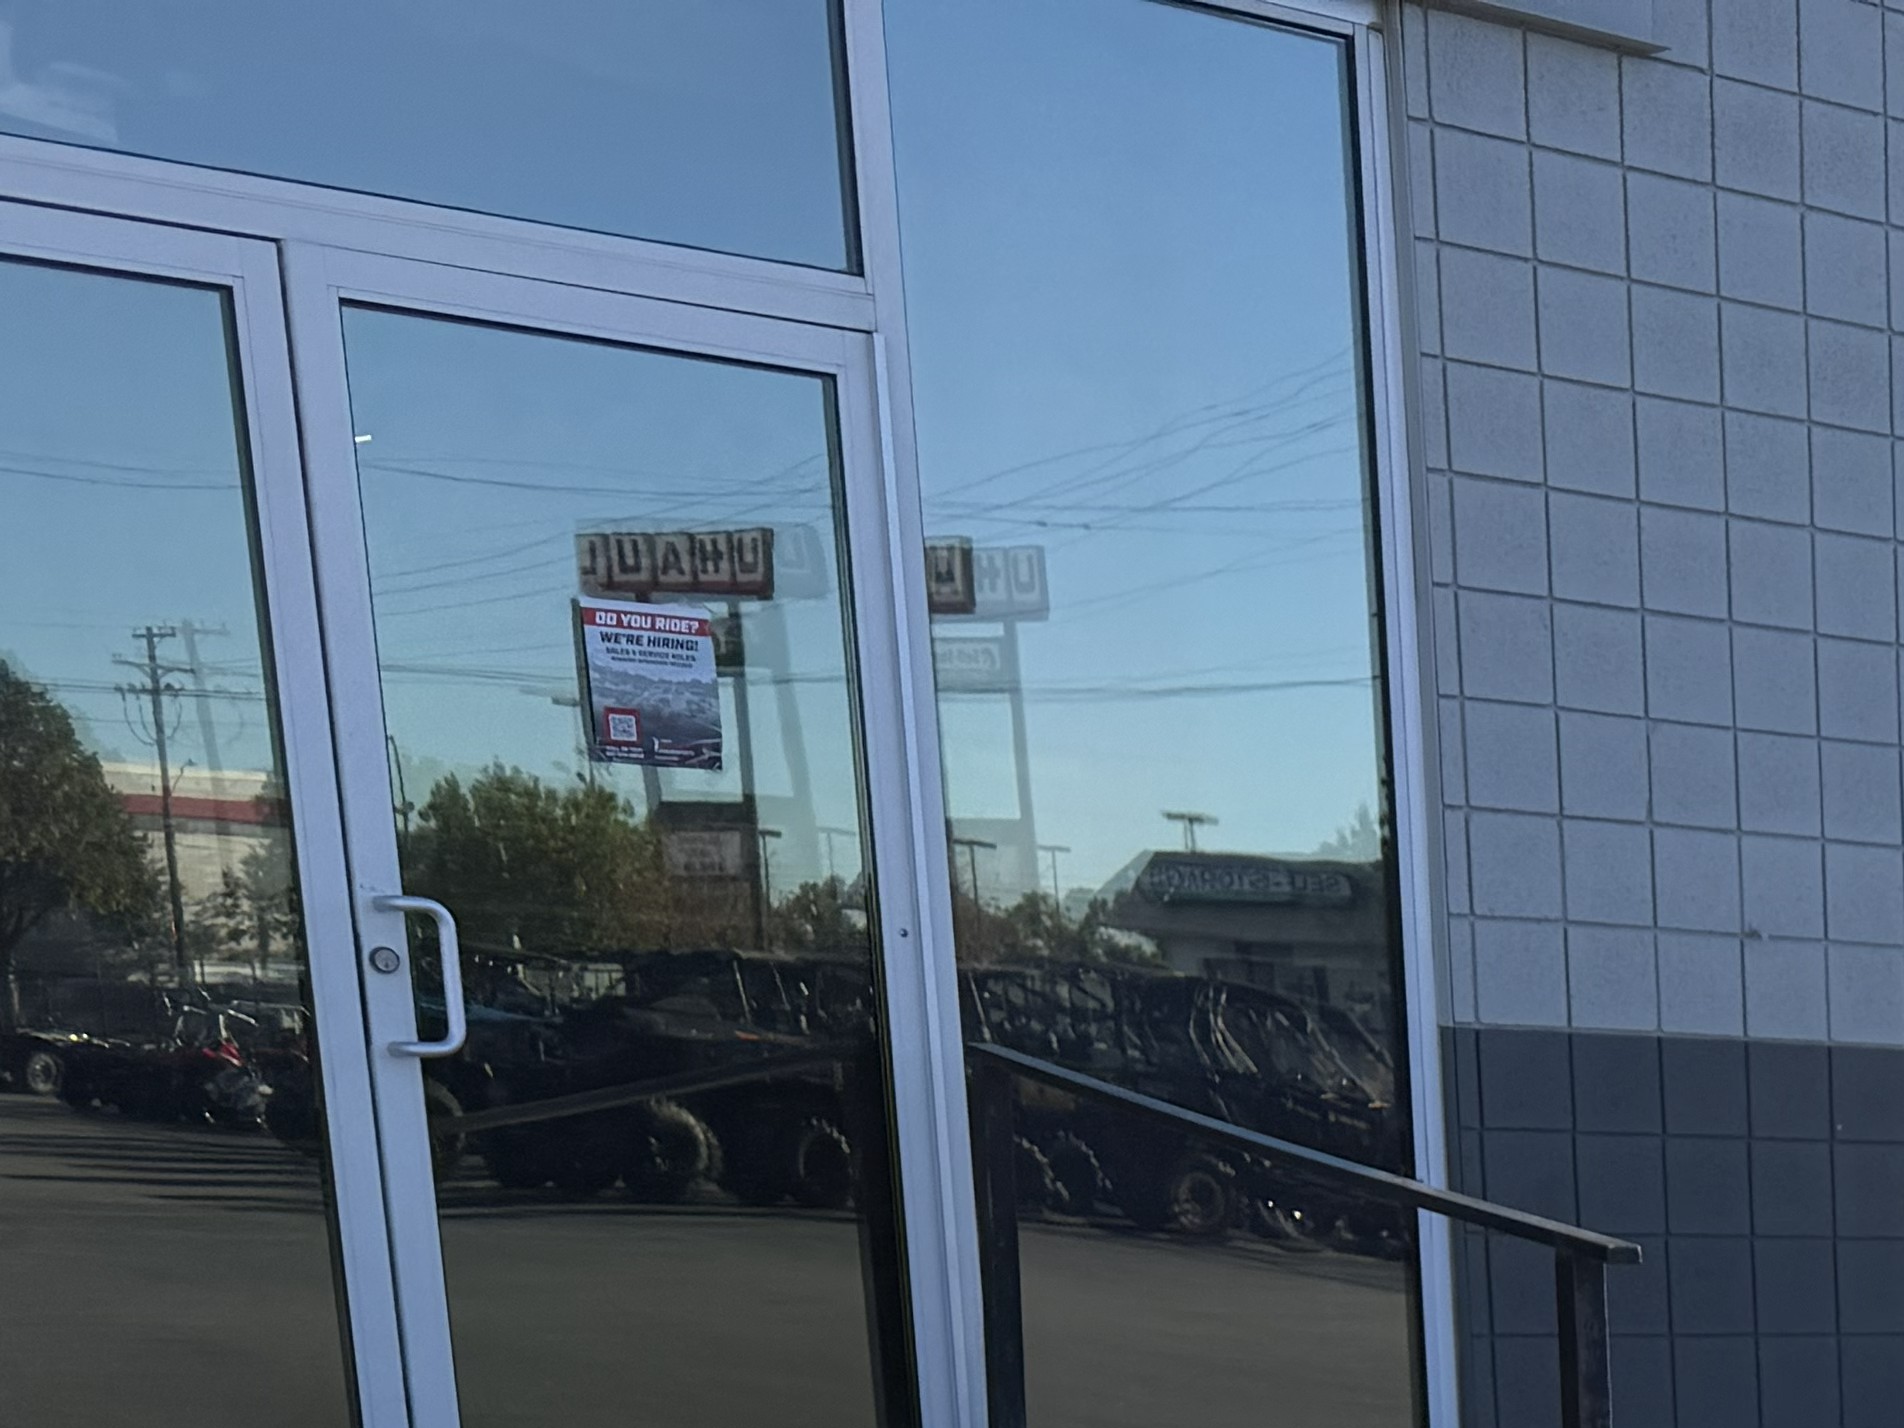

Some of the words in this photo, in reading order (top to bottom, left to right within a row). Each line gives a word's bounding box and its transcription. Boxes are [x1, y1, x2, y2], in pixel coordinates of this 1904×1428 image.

[595, 611, 617, 626] DO
[620, 613, 652, 629] YOU
[655, 617, 700, 634] RIDE?
[600, 631, 643, 647] WE'RE
[647, 636, 699, 652] HIRING!
